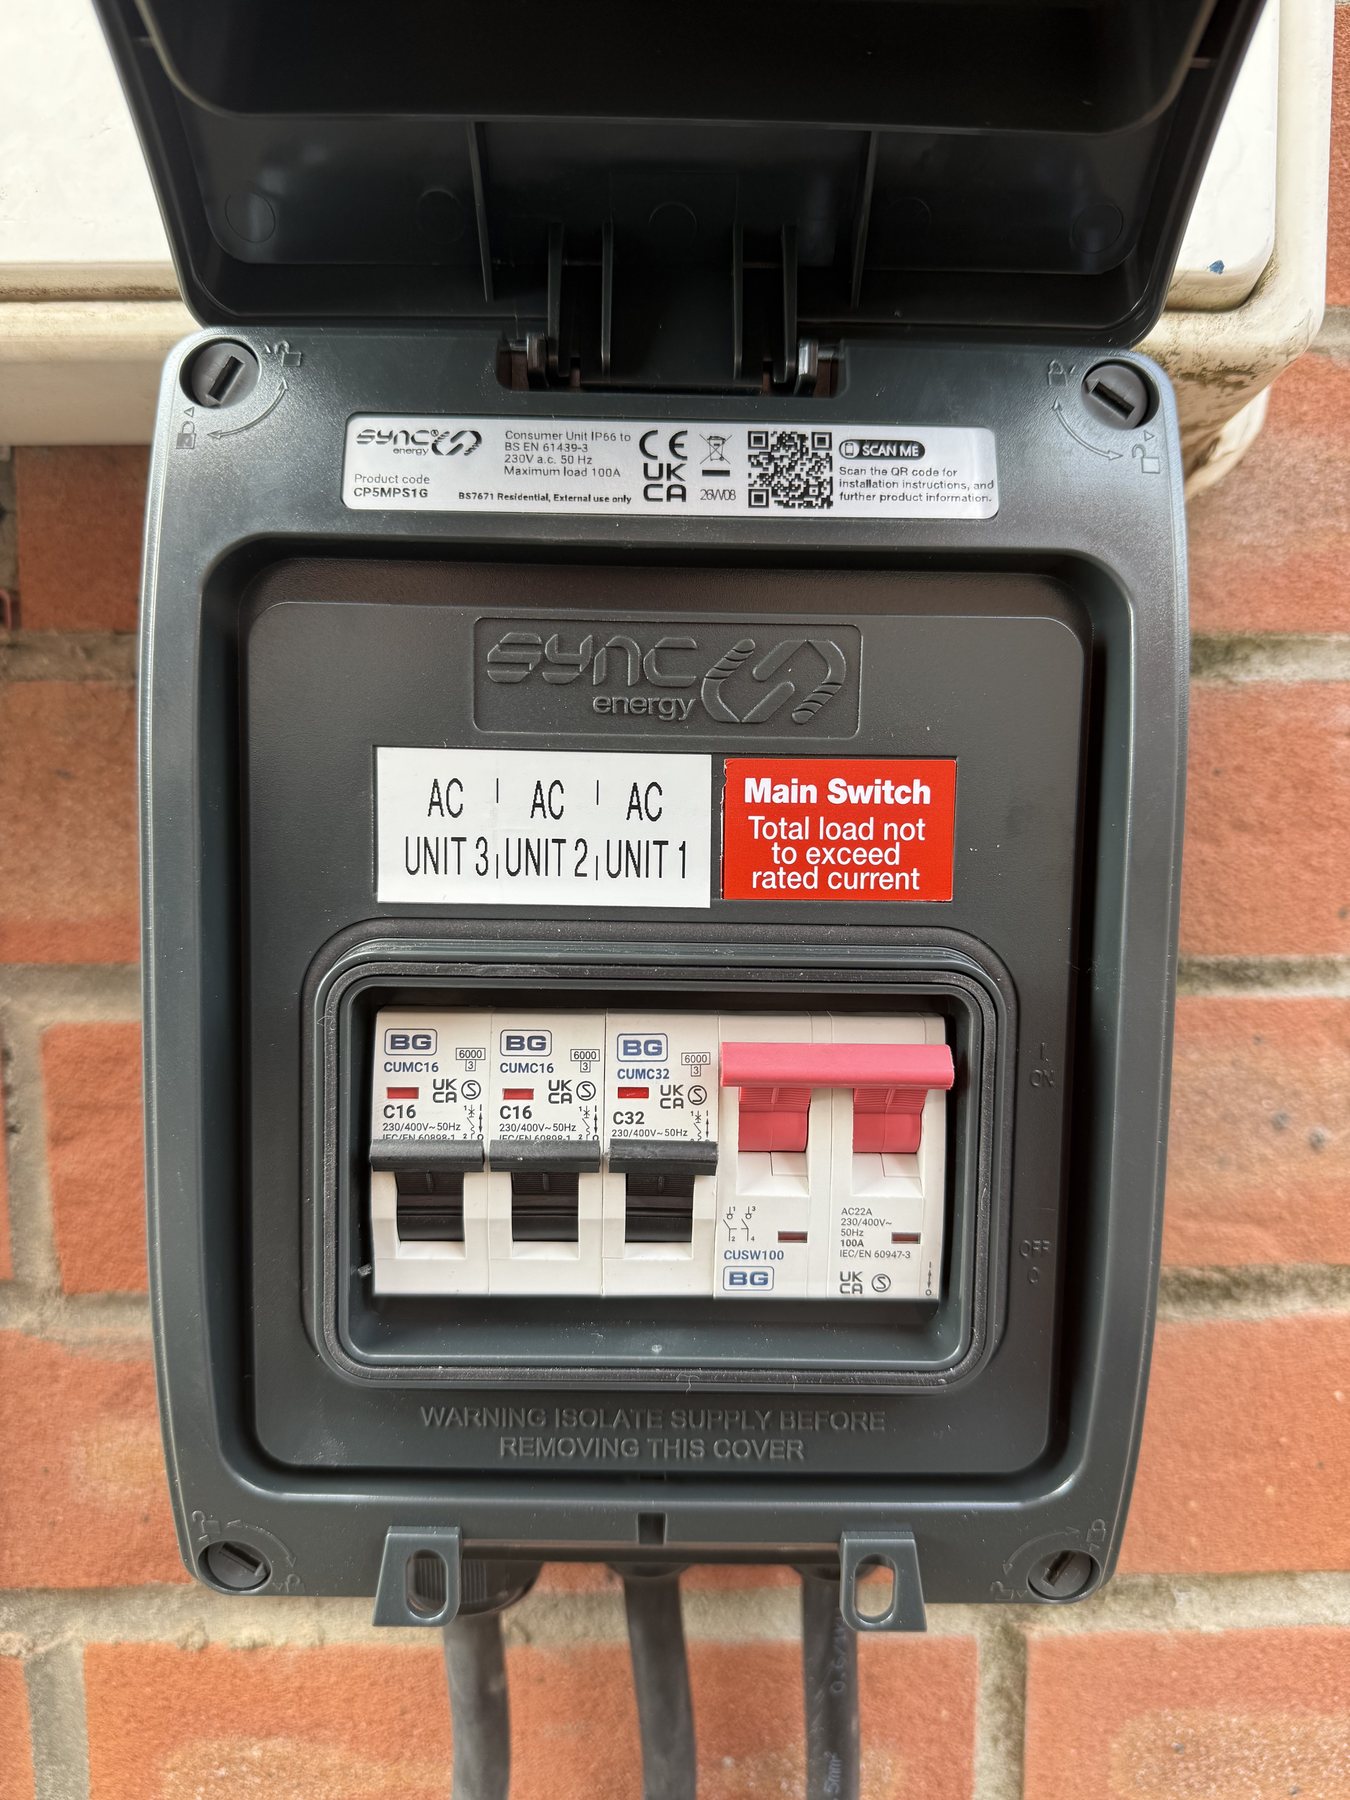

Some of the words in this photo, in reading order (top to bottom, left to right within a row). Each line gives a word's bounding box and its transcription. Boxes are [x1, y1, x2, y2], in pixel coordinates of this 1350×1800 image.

[505, 431, 562, 440] Consumer
[566, 431, 587, 441] Unit
[591, 432, 616, 442] IP66
[620, 433, 631, 442] to
[505, 443, 520, 452] BS
[524, 443, 538, 452] EN
[543, 444, 588, 452] 61439-3
[639, 430, 688, 460] CE
[862, 445, 896, 457] SCAN
[900, 445, 919, 457] ME
[392, 448, 430, 456] energy
[504, 454, 534, 464] 230V
[537, 456, 556, 464] a.c.
[561, 455, 574, 464] 50
[578, 456, 592, 464] Hz
[504, 466, 560, 476] Maximum
[564, 467, 587, 476] load
[592, 468, 620, 478] 100A
[643, 462, 686, 482] UK
[839, 466, 866, 476] Scan
[870, 466, 888, 476] the
[891, 467, 908, 476] QR
[912, 468, 940, 476] code
[942, 468, 958, 476] for
[354, 474, 398, 484] Product
[402, 474, 430, 484] code
[839, 479, 898, 488] installation
[902, 480, 970, 490] instructions,
[974, 480, 994, 490] and
[354, 488, 428, 498] CP5MPS1G
[458, 492, 494, 500] BS7671
[498, 493, 551, 502] Residential,
[554, 494, 591, 502] External
[612, 494, 632, 504] only
[643, 484, 686, 502] CA
[840, 493, 876, 501] further
[880, 493, 922, 503] product
[926, 494, 992, 502] information.
[592, 696, 696, 722] energy
[745, 778, 818, 804] Main
[827, 778, 931, 804] Switch
[428, 778, 464, 818] AC
[530, 780, 564, 820] AC
[626, 782, 663, 822] AC
[748, 816, 810, 840] Total
[819, 816, 874, 840] load
[884, 818, 926, 841] not
[405, 836, 467, 875] UNIT
[476, 836, 489, 876] 3
[506, 838, 566, 876] UNIT
[574, 838, 588, 877] 2
[606, 840, 669, 878] UNIT
[678, 840, 686, 878] 1
[772, 842, 797, 865] to
[806, 842, 900, 866] exceed
[752, 866, 818, 890] rated
[827, 868, 920, 890] current
[390, 1034, 432, 1050] BG
[506, 1036, 546, 1051] BG
[622, 1040, 662, 1056] BG
[459, 1050, 482, 1058] 6000
[574, 1051, 596, 1060] 6000
[684, 1054, 708, 1063] 6000
[384, 1062, 439, 1072] CUMC16
[468, 1062, 474, 1070] 3
[500, 1063, 554, 1074] CUMC16
[582, 1062, 588, 1070] 3
[617, 1068, 670, 1080] CUMC32
[384, 1104, 416, 1118] C16
[500, 1106, 532, 1120] C16
[613, 1111, 645, 1124] C32
[841, 1208, 872, 1216] AC22A
[840, 1228, 864, 1236] 50Hz
[840, 1239, 864, 1247] 100A
[1020, 1240, 1050, 1257] OFF
[724, 1250, 784, 1260] CUSW100
[840, 1250, 872, 1258] IEC/EN
[874, 1250, 911, 1258] 60947-3
[728, 1271, 768, 1286] BG
[420, 1406, 547, 1428] WARNING
[555, 1408, 662, 1430] ISOLATE
[670, 1408, 772, 1430] SUPPLY
[780, 1410, 886, 1432] BEFORE
[500, 1436, 640, 1458] REMOVING
[648, 1438, 706, 1459] THIS
[713, 1438, 804, 1460] COVER
